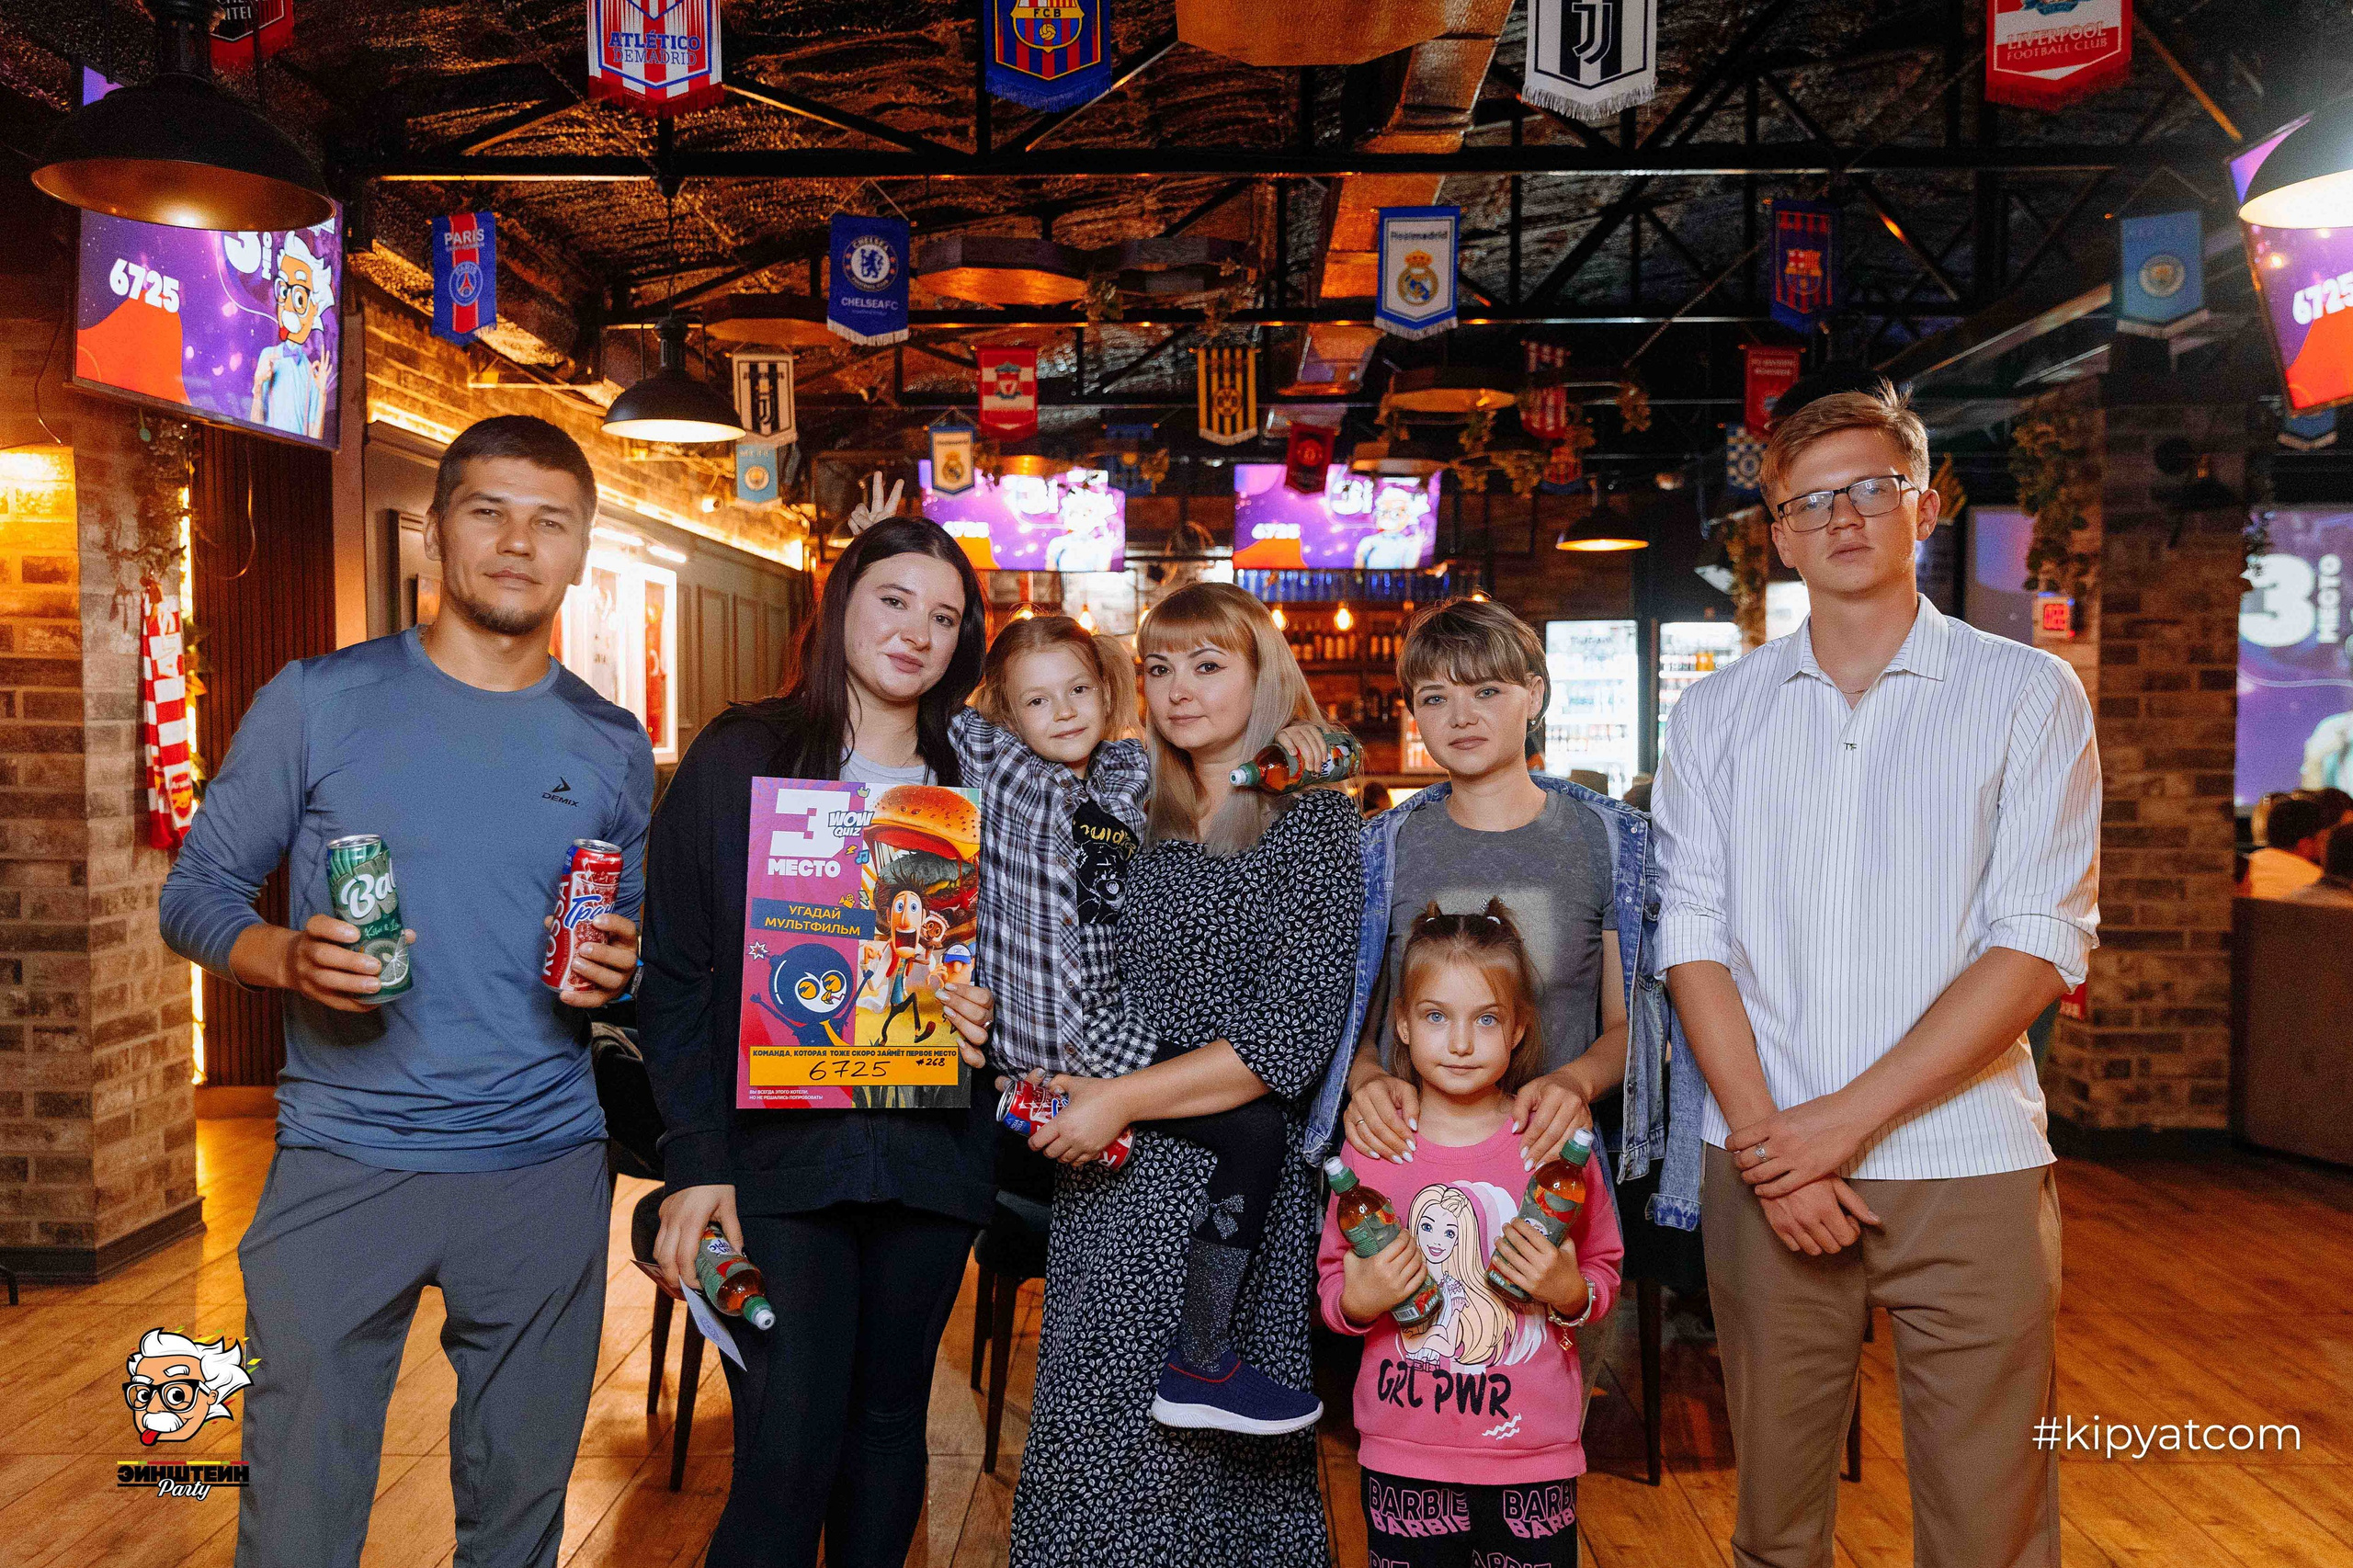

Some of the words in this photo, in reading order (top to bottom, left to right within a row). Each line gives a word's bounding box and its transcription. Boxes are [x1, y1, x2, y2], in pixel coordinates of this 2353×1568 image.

[608, 29, 701, 51] ATLÉTICO
[2006, 20, 2107, 50] LIVERPOOL
[2006, 44, 2070, 61] FOOTBALL
[2074, 38, 2109, 51] CLUB
[444, 228, 484, 245] PARIS
[109, 258, 180, 312] 6725
[2292, 271, 2353, 324] 6725
[2239, 554, 2316, 647] 3
[541, 792, 579, 807] DEMIX
[769, 789, 851, 858] 3
[828, 811, 875, 827] WOW
[833, 826, 862, 838] QUIZ
[767, 858, 841, 878] МЕСТО
[789, 904, 842, 920] УГАДАЙ
[765, 916, 861, 936] МУЛЬТФИЛЬМ
[753, 1050, 792, 1058] КОМАНДА,
[877, 1048, 905, 1057] ЗАЙМЁТ
[809, 1060, 891, 1081] 6725
[1377, 1358, 1424, 1408] GRL
[1432, 1369, 1512, 1419] PWR
[1369, 1476, 1470, 1521] BARBIE
[1370, 1507, 1472, 1538] BARBIE
